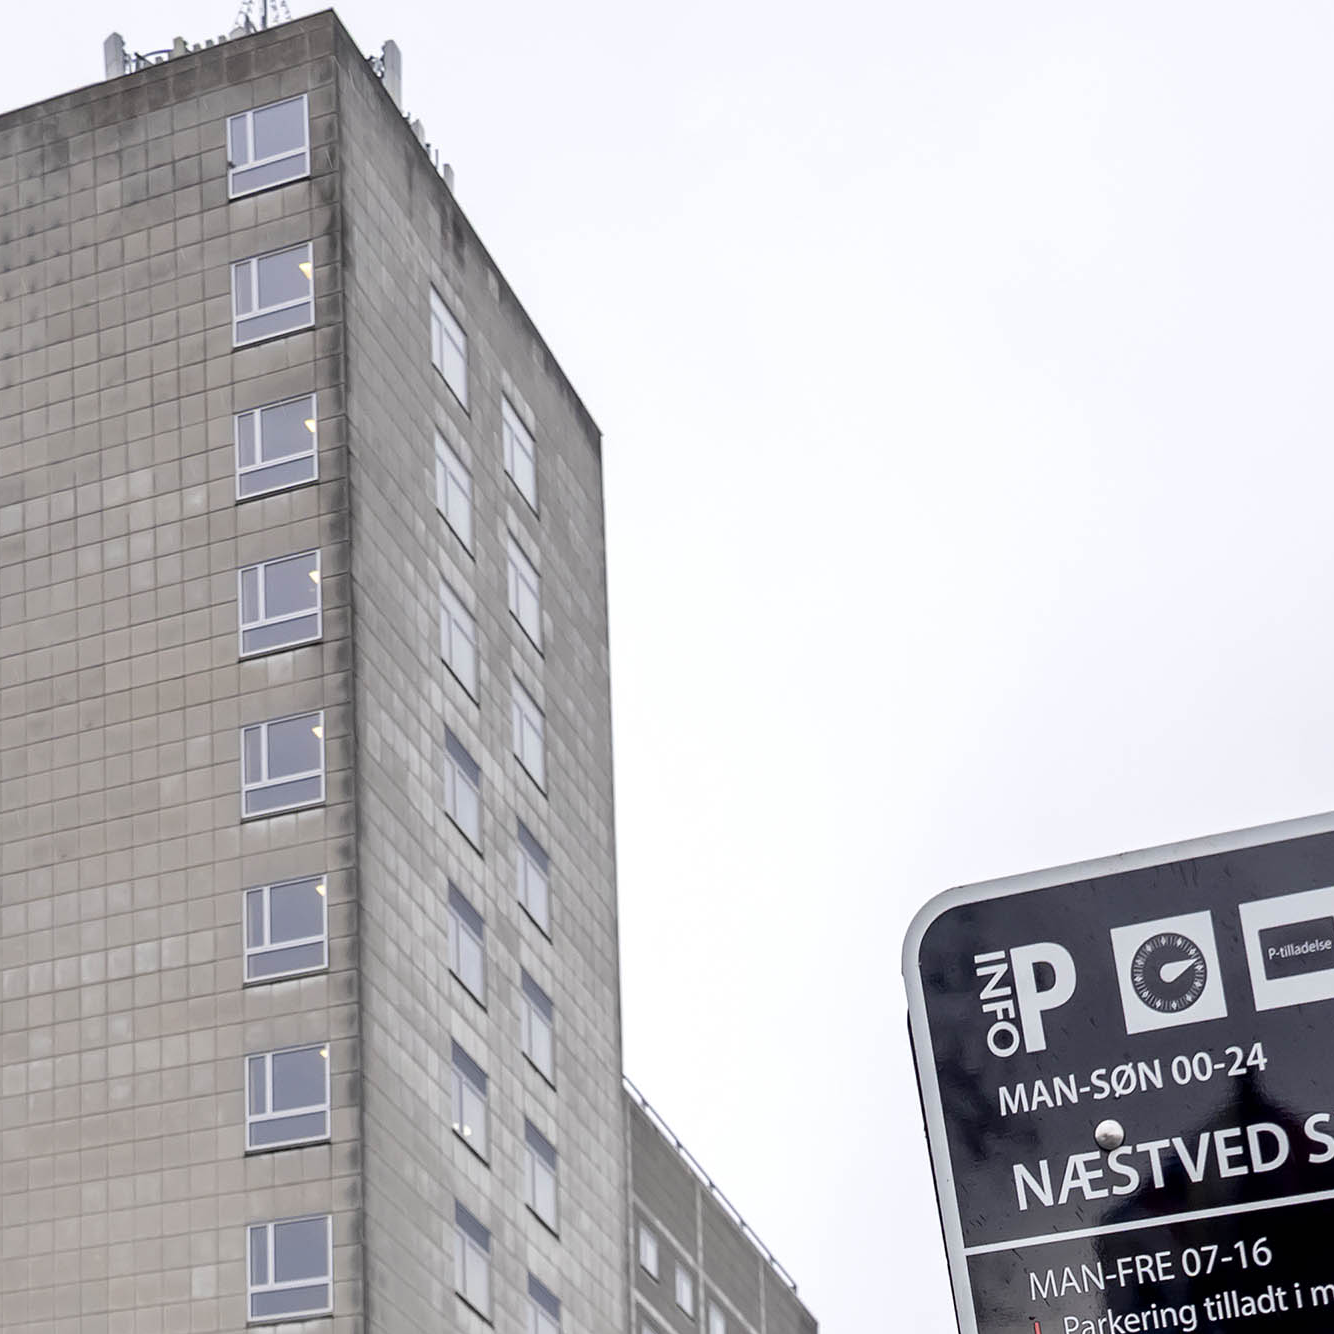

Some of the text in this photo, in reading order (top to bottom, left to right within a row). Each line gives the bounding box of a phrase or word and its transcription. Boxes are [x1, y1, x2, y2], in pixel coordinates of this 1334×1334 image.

[1267, 938, 1333, 961] P-tilladelse
[974, 950, 1021, 1058] INFO
[1010, 941, 1077, 1054] P
[998, 1042, 1269, 1117] MAN-SØN 00-24
[1012, 1122, 1291, 1210] NÆSTVED
[1028, 1236, 1273, 1304] MAN-FRE 07-16
[1203, 1285, 1289, 1322] tilladt
[1294, 1282, 1304, 1309] i
